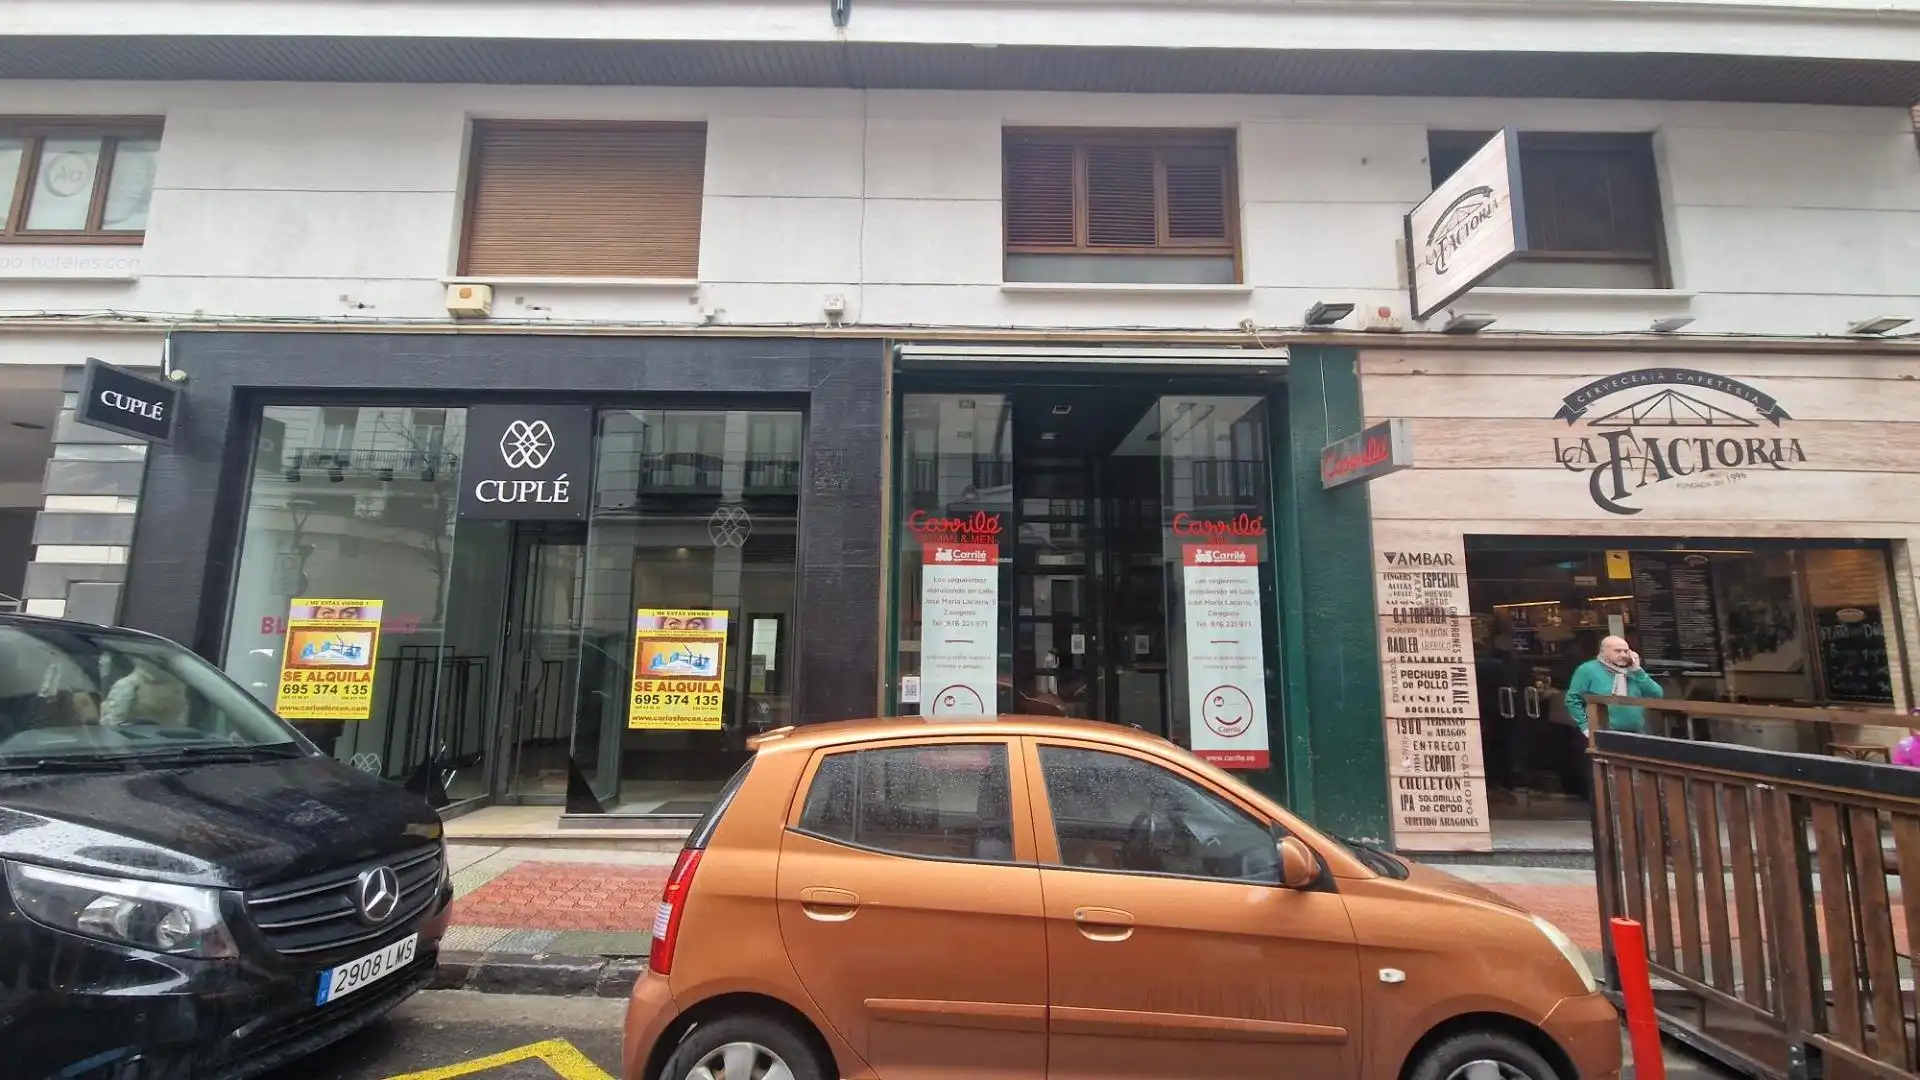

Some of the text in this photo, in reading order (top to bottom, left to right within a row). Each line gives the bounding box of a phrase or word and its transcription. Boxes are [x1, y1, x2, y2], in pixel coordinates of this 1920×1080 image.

[100, 390, 164, 421] CUPLÉ
[1552, 427, 1808, 515] LA FACTORIA
[475, 472, 570, 503] CUPLÉ
[1398, 552, 1455, 566] AMBAR
[1422, 572, 1460, 588] ESPECIAL
[1424, 590, 1453, 598] HUEVOS
[1387, 637, 1419, 653] RADLER
[1400, 655, 1463, 664] CALAMARES
[283, 671, 371, 683] SE ALQUILA
[283, 684, 368, 695] 695 374 135
[634, 681, 721, 693] SE ALQUILA
[1417, 680, 1448, 689] POLLO
[635, 694, 719, 706] 695 374 135
[1405, 706, 1464, 714] BOCADILLOS
[1396, 718, 1421, 735] 1900
[1413, 740, 1467, 751] ENTRECOT
[1424, 754, 1456, 772] EXPORT
[1400, 794, 1415, 812] IPA
[1418, 795, 1462, 803] SOLOMILLO
[1404, 816, 1437, 826] SURTIDO
[334, 954, 383, 993] 2908
[385, 939, 414, 971] LMS
